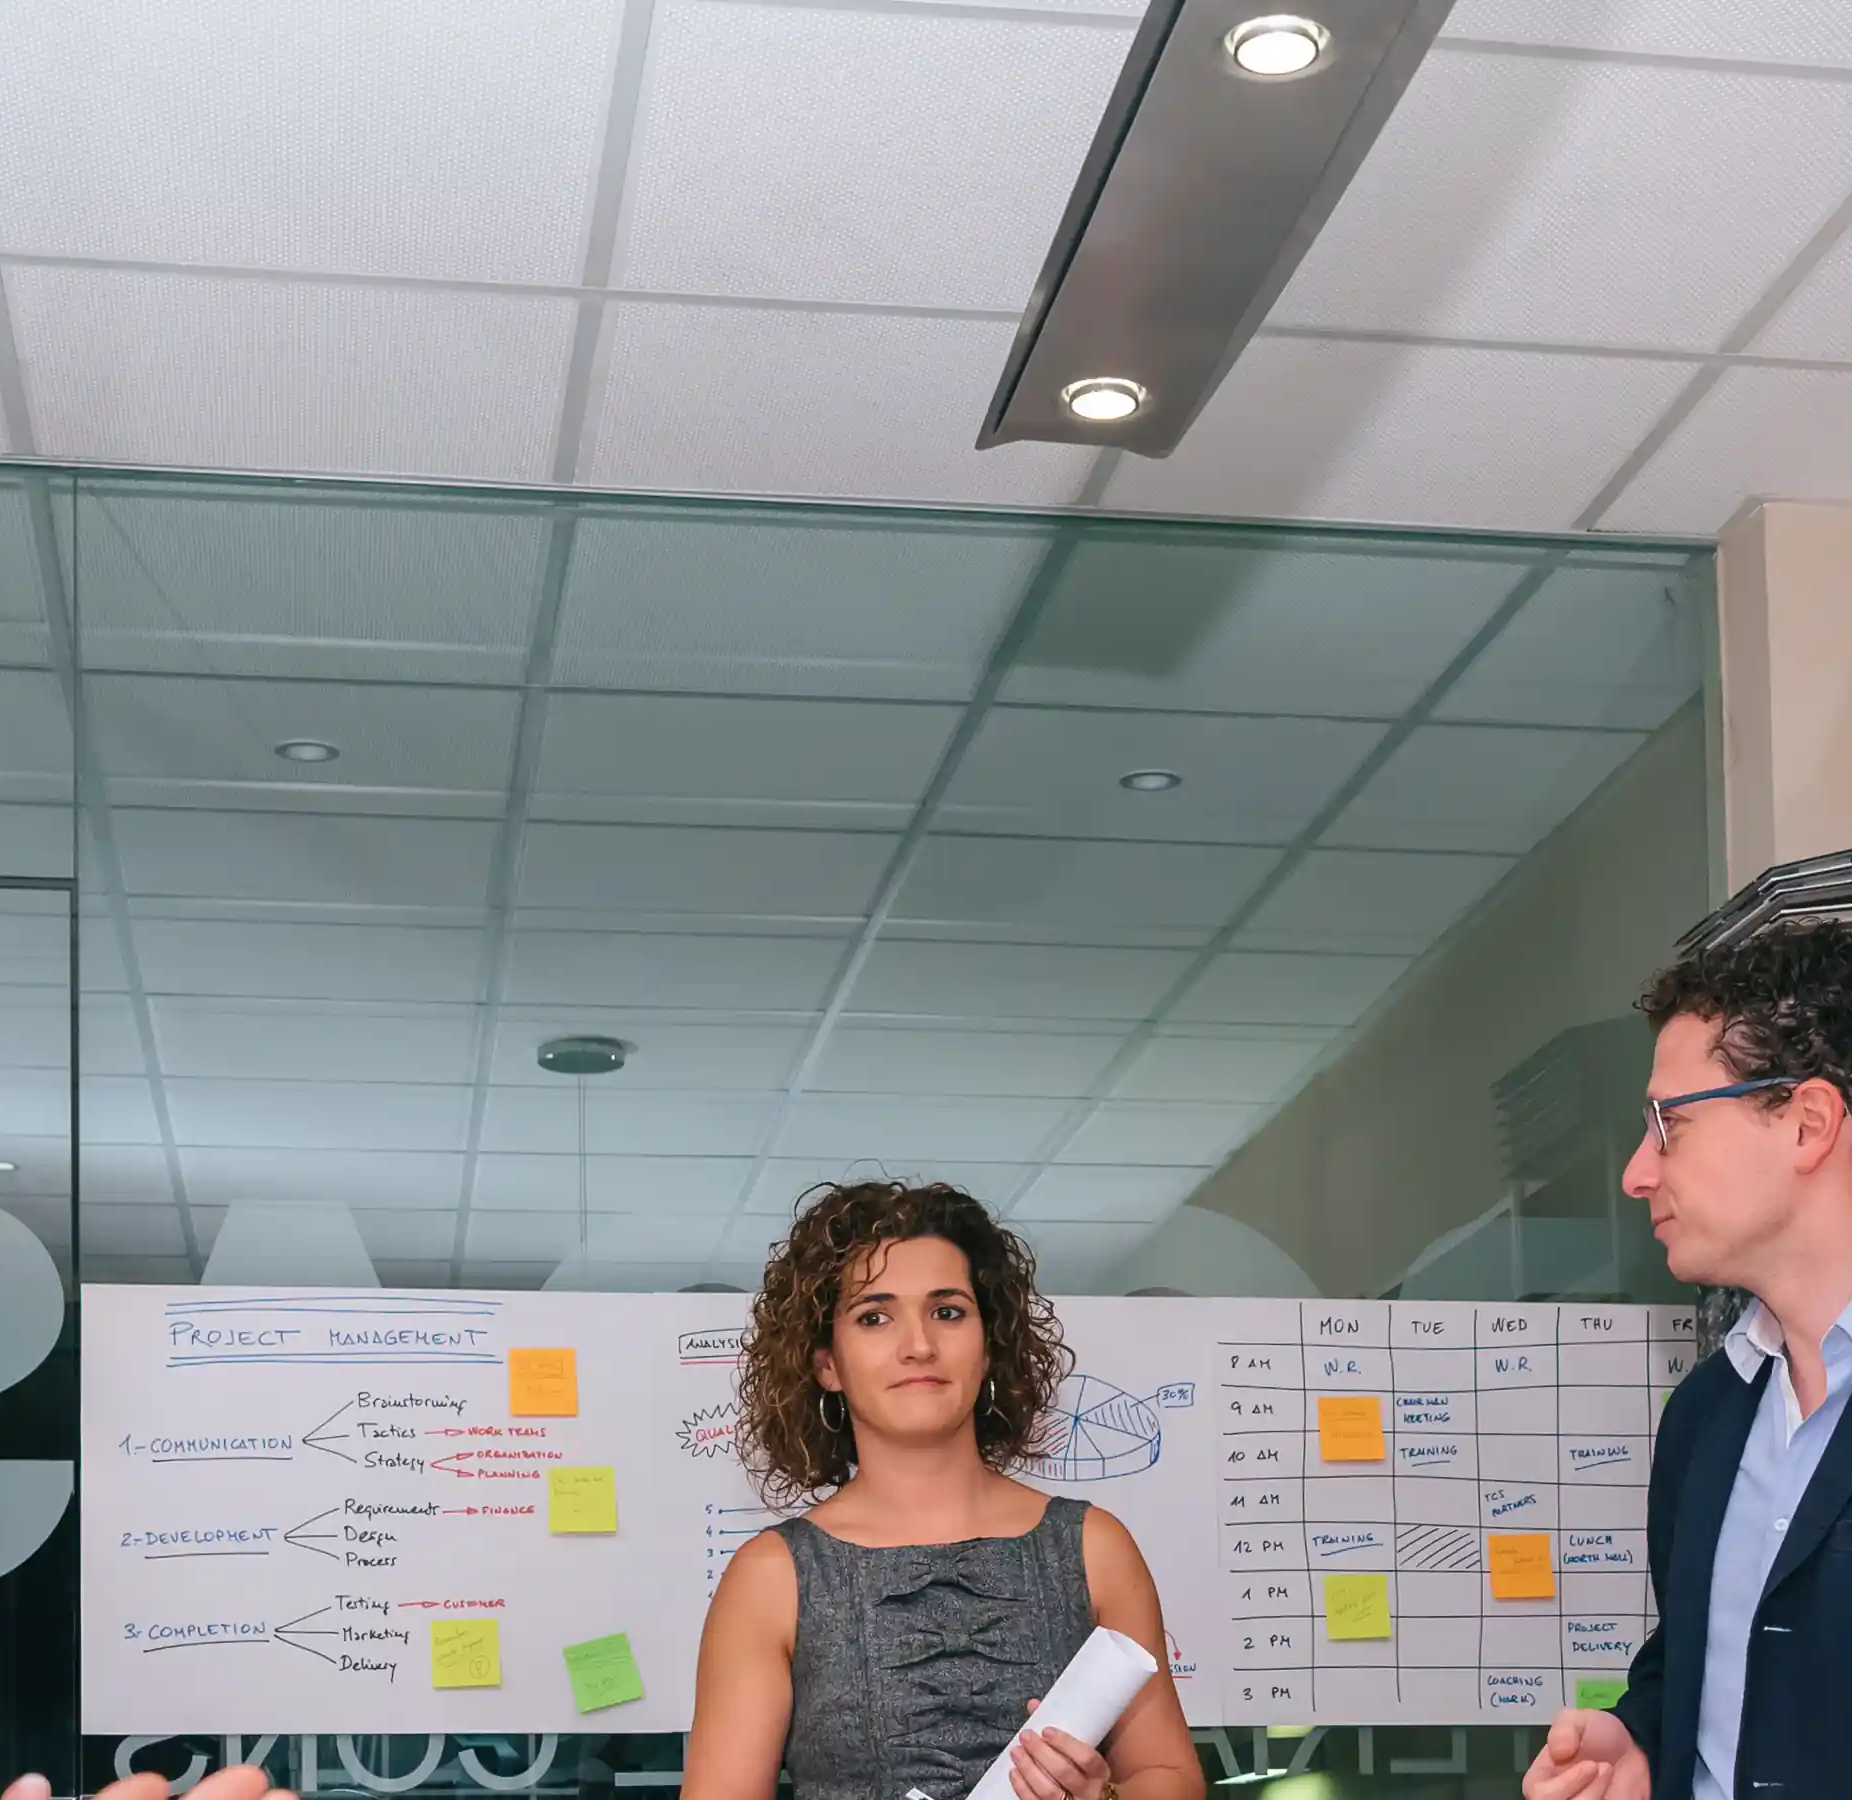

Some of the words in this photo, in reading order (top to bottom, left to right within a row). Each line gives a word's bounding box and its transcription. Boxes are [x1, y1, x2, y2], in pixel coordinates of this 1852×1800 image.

[1319, 1316, 1360, 1335] MON
[1411, 1320, 1445, 1335] TUE
[1491, 1317, 1528, 1333] WED
[1580, 1317, 1613, 1331] THU
[169, 1321, 302, 1347] PROJECT
[329, 1328, 488, 1347] MANAGEMENT
[686, 1338, 741, 1350] ANALYSI
[1230, 1355, 1240, 1369] 8
[1248, 1357, 1272, 1370] AM
[1323, 1357, 1362, 1377] W.R.
[1495, 1356, 1533, 1373] W.R.
[1162, 1387, 1189, 1401] 30%
[357, 1391, 468, 1416] Brainstorming
[1230, 1401, 1243, 1416] 9
[1251, 1403, 1274, 1415] AM
[357, 1423, 416, 1438] Tactics
[468, 1426, 503, 1437] WORK
[508, 1427, 547, 1438] TEAMS
[695, 1425, 734, 1443] QUAL
[1227, 1451, 1246, 1463] 10
[1256, 1449, 1279, 1462] AM
[1399, 1445, 1458, 1460] TRAINING
[1569, 1445, 1629, 1461] TRAINING
[364, 1451, 425, 1474] Strategy
[477, 1468, 541, 1480] PLANNING
[1230, 1496, 1246, 1508] 11
[1258, 1493, 1281, 1505] AM
[481, 1504, 536, 1516] FINANCE
[705, 1503, 713, 1514] 5
[344, 1525, 398, 1547] Design
[706, 1525, 713, 1538] 4
[1312, 1532, 1374, 1546] TRAINING
[1232, 1540, 1253, 1554] 12
[1262, 1540, 1285, 1552] PM
[1569, 1534, 1613, 1547] LUNCH
[345, 1551, 397, 1567] Process
[707, 1548, 714, 1557] 3
[707, 1570, 714, 1579] 2
[1241, 1587, 1252, 1601] 1
[1268, 1586, 1289, 1599] PM
[335, 1595, 390, 1615] Testing
[443, 1599, 506, 1609] CUSTOMER
[1567, 1621, 1619, 1634] PROJECT
[343, 1627, 410, 1645] Marketing
[1243, 1637, 1256, 1650] 2
[1270, 1634, 1292, 1649] PM
[1571, 1640, 1633, 1656] DELIVERY
[339, 1655, 397, 1683] Delivery
[1487, 1674, 1543, 1686] COACHING
[1243, 1687, 1254, 1701] 3
[1271, 1686, 1292, 1700] PM
